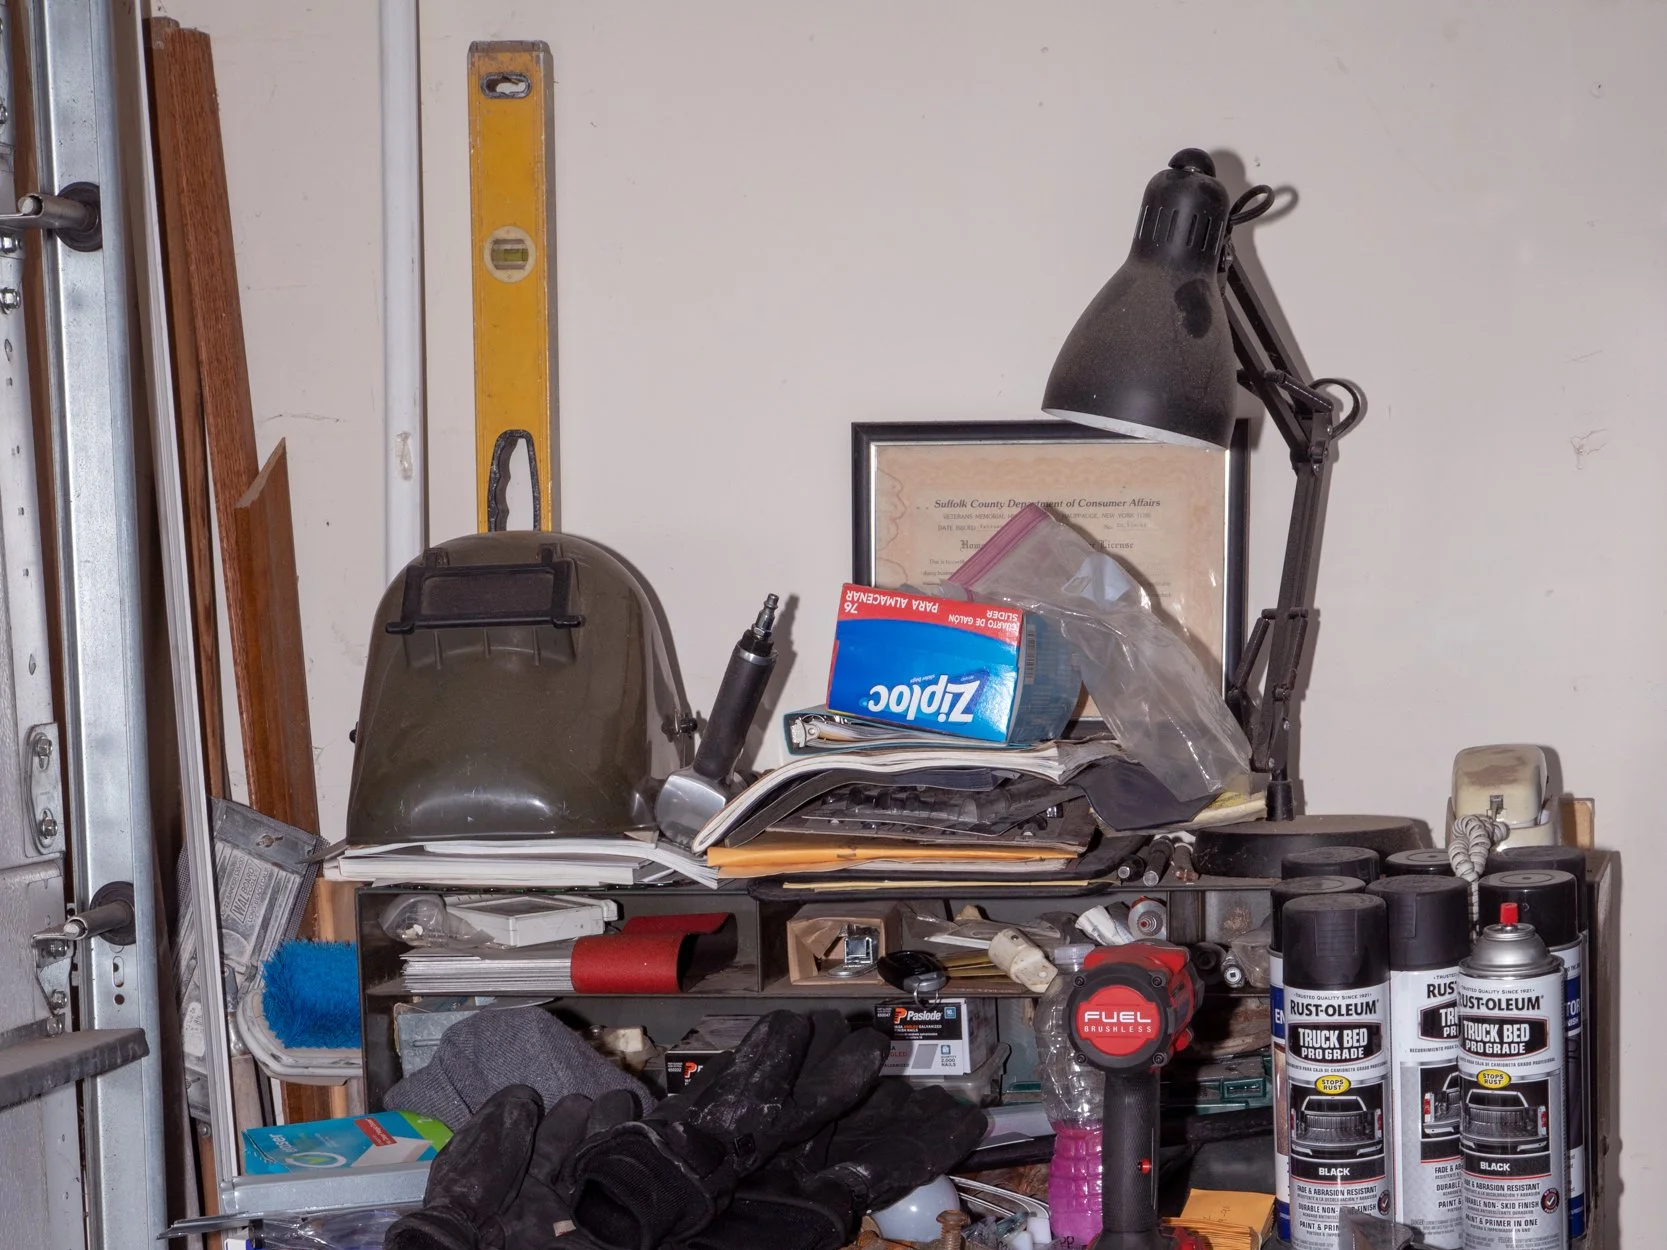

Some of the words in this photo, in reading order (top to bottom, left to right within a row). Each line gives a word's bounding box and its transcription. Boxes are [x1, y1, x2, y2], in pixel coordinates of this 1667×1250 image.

[934, 499, 967, 508] Suffolk
[970, 499, 1004, 510] County
[1007, 499, 1064, 510] Deptment
[1066, 499, 1075, 507] of
[1078, 499, 1126, 507] Consumer
[1128, 498, 1161, 507] Affairs
[845, 590, 908, 607] ALMACENAR
[912, 599, 939, 613] PARA
[844, 602, 858, 614] 76
[948, 613, 973, 626] GALÓN
[986, 609, 1018, 621] SLIDER
[975, 619, 986, 627] DE
[867, 675, 981, 723] Ziploc
[1427, 981, 1457, 998] RUS
[1290, 999, 1377, 1017] RUST-OLEUM
[906, 1010, 942, 1021] Paslode
[1084, 1011, 1152, 1023] FUEL
[1084, 1025, 1152, 1033] BRUSHLESS
[1463, 1020, 1500, 1042] TRUCK
[1503, 1023, 1530, 1042] BED
[1298, 1028, 1340, 1048] TRUCK
[1343, 1028, 1368, 1048] BED
[1465, 1040, 1484, 1053] PRO
[1485, 1042, 1526, 1054] GRADE
[1301, 1047, 1323, 1059] PRO
[1324, 1047, 1365, 1060] GRADE
[1318, 1167, 1351, 1176] BLACK
[1434, 1165, 1448, 1174] FADE
[1480, 1161, 1511, 1171] BLACK
[1313, 1187, 1345, 1197] ABRASION
[1346, 1185, 1377, 1196] RESISTANT
[1436, 1181, 1461, 1191] DURABLE
[1476, 1182, 1505, 1192] ABRASION
[1506, 1182, 1540, 1192] RESISTANT
[1298, 1202, 1320, 1213] DURABLE
[1438, 1199, 1456, 1208] PAINT
[1483, 1200, 1499, 1208] NON-
[1500, 1201, 1516, 1209] SKID
[1518, 1200, 1540, 1209] FINISH
[1299, 1220, 1315, 1230] PAINT
[1485, 1219, 1511, 1227] PRIMER
